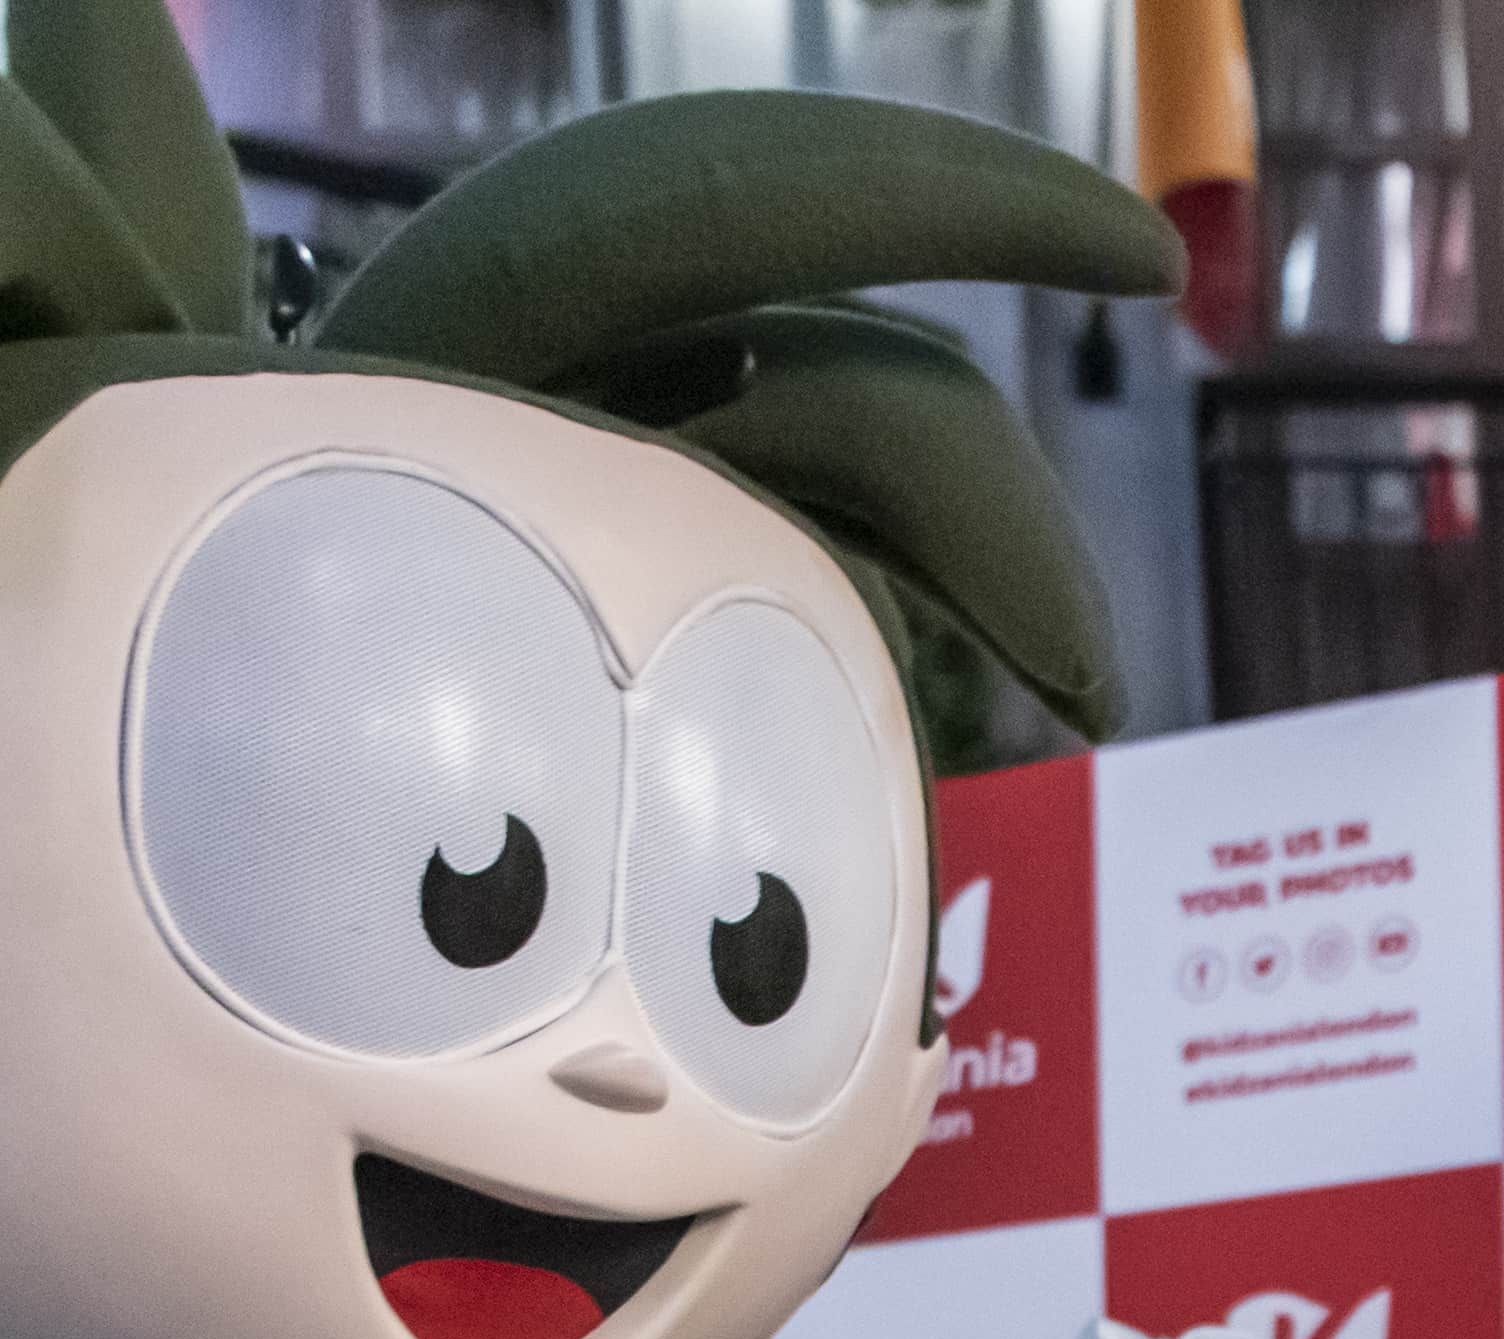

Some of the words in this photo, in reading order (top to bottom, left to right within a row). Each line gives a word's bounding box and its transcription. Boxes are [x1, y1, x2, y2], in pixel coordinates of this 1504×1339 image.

[1210, 838, 1272, 870] TAG
[1282, 827, 1324, 857] US
[1334, 821, 1369, 848] IN
[1180, 881, 1268, 916] YOUR
[1277, 855, 1414, 901] PHOTOS
